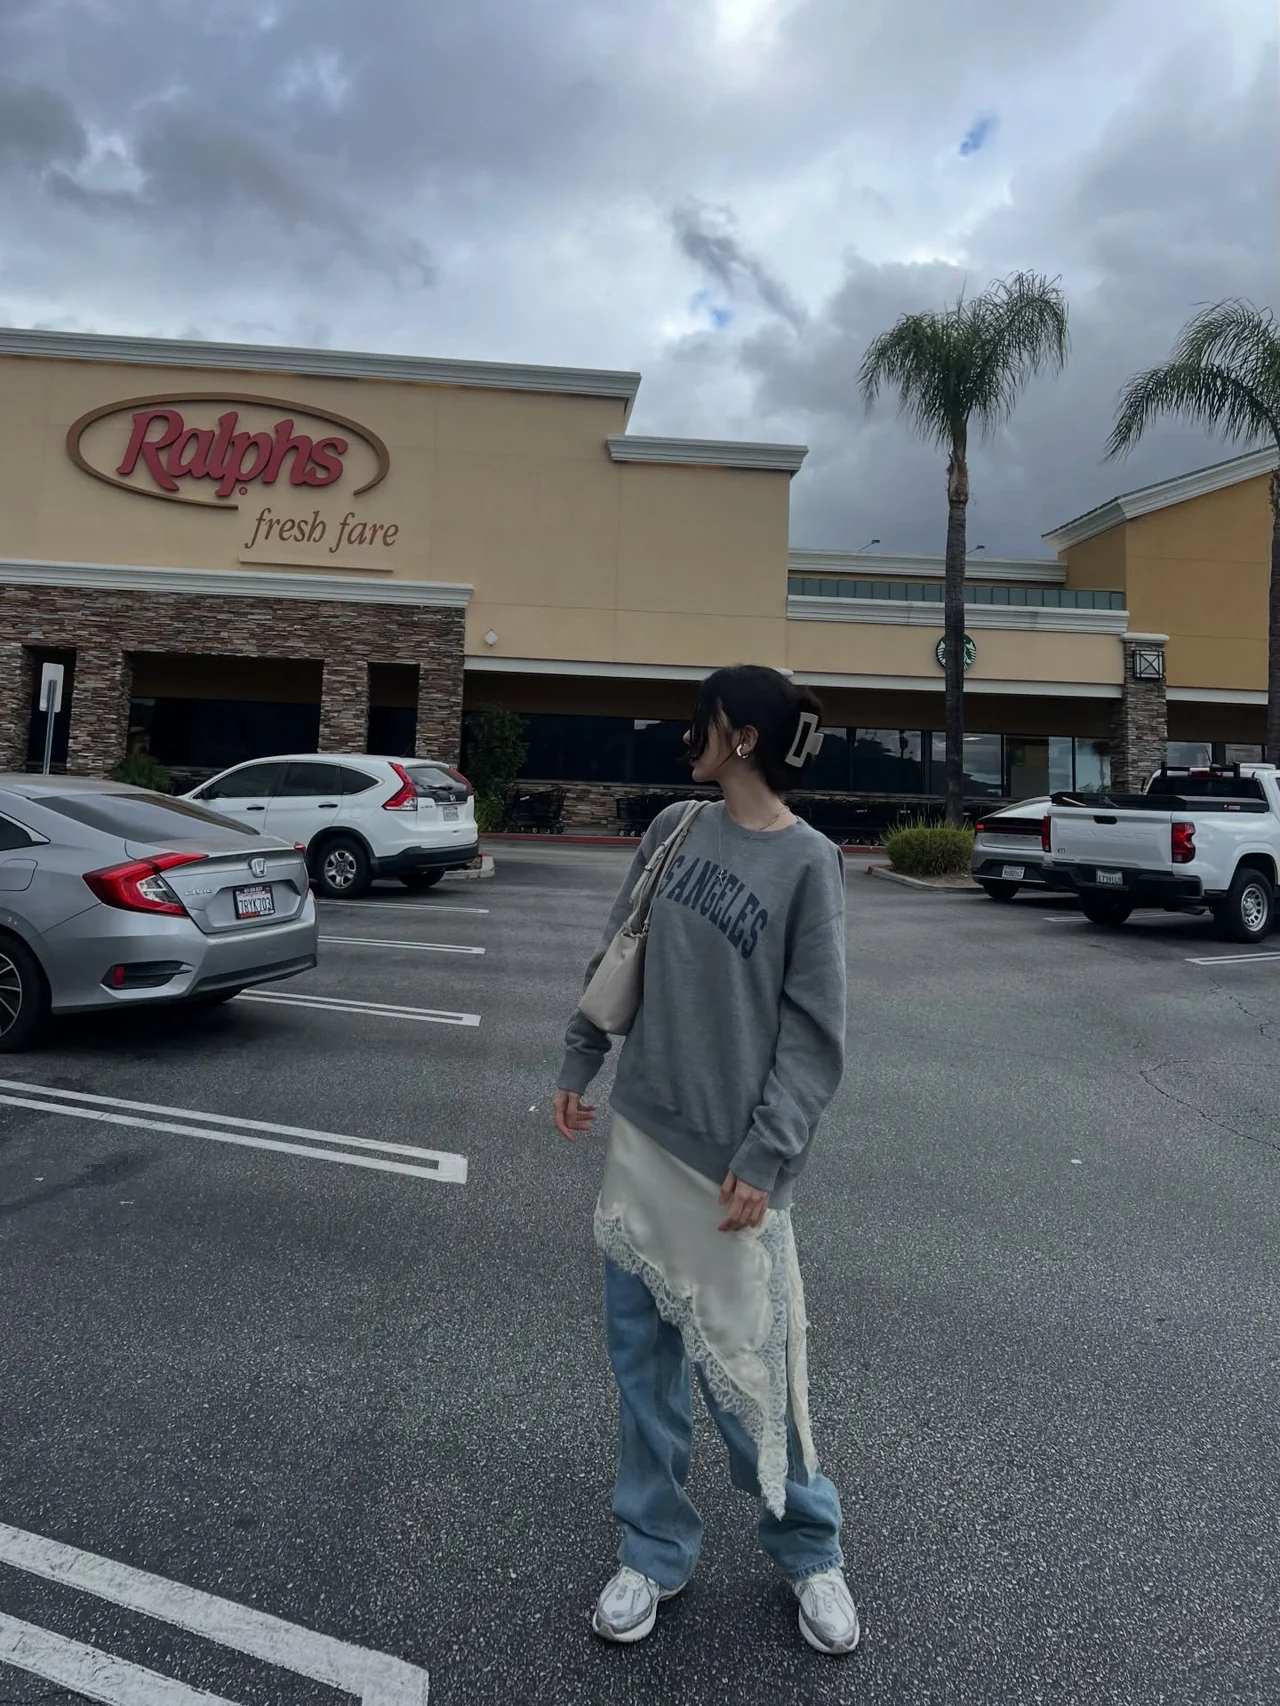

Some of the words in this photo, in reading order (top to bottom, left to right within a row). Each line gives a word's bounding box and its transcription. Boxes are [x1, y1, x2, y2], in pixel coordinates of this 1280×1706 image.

[116, 409, 348, 497] Ralphs
[245, 507, 327, 549] fresh
[329, 511, 399, 553] fare
